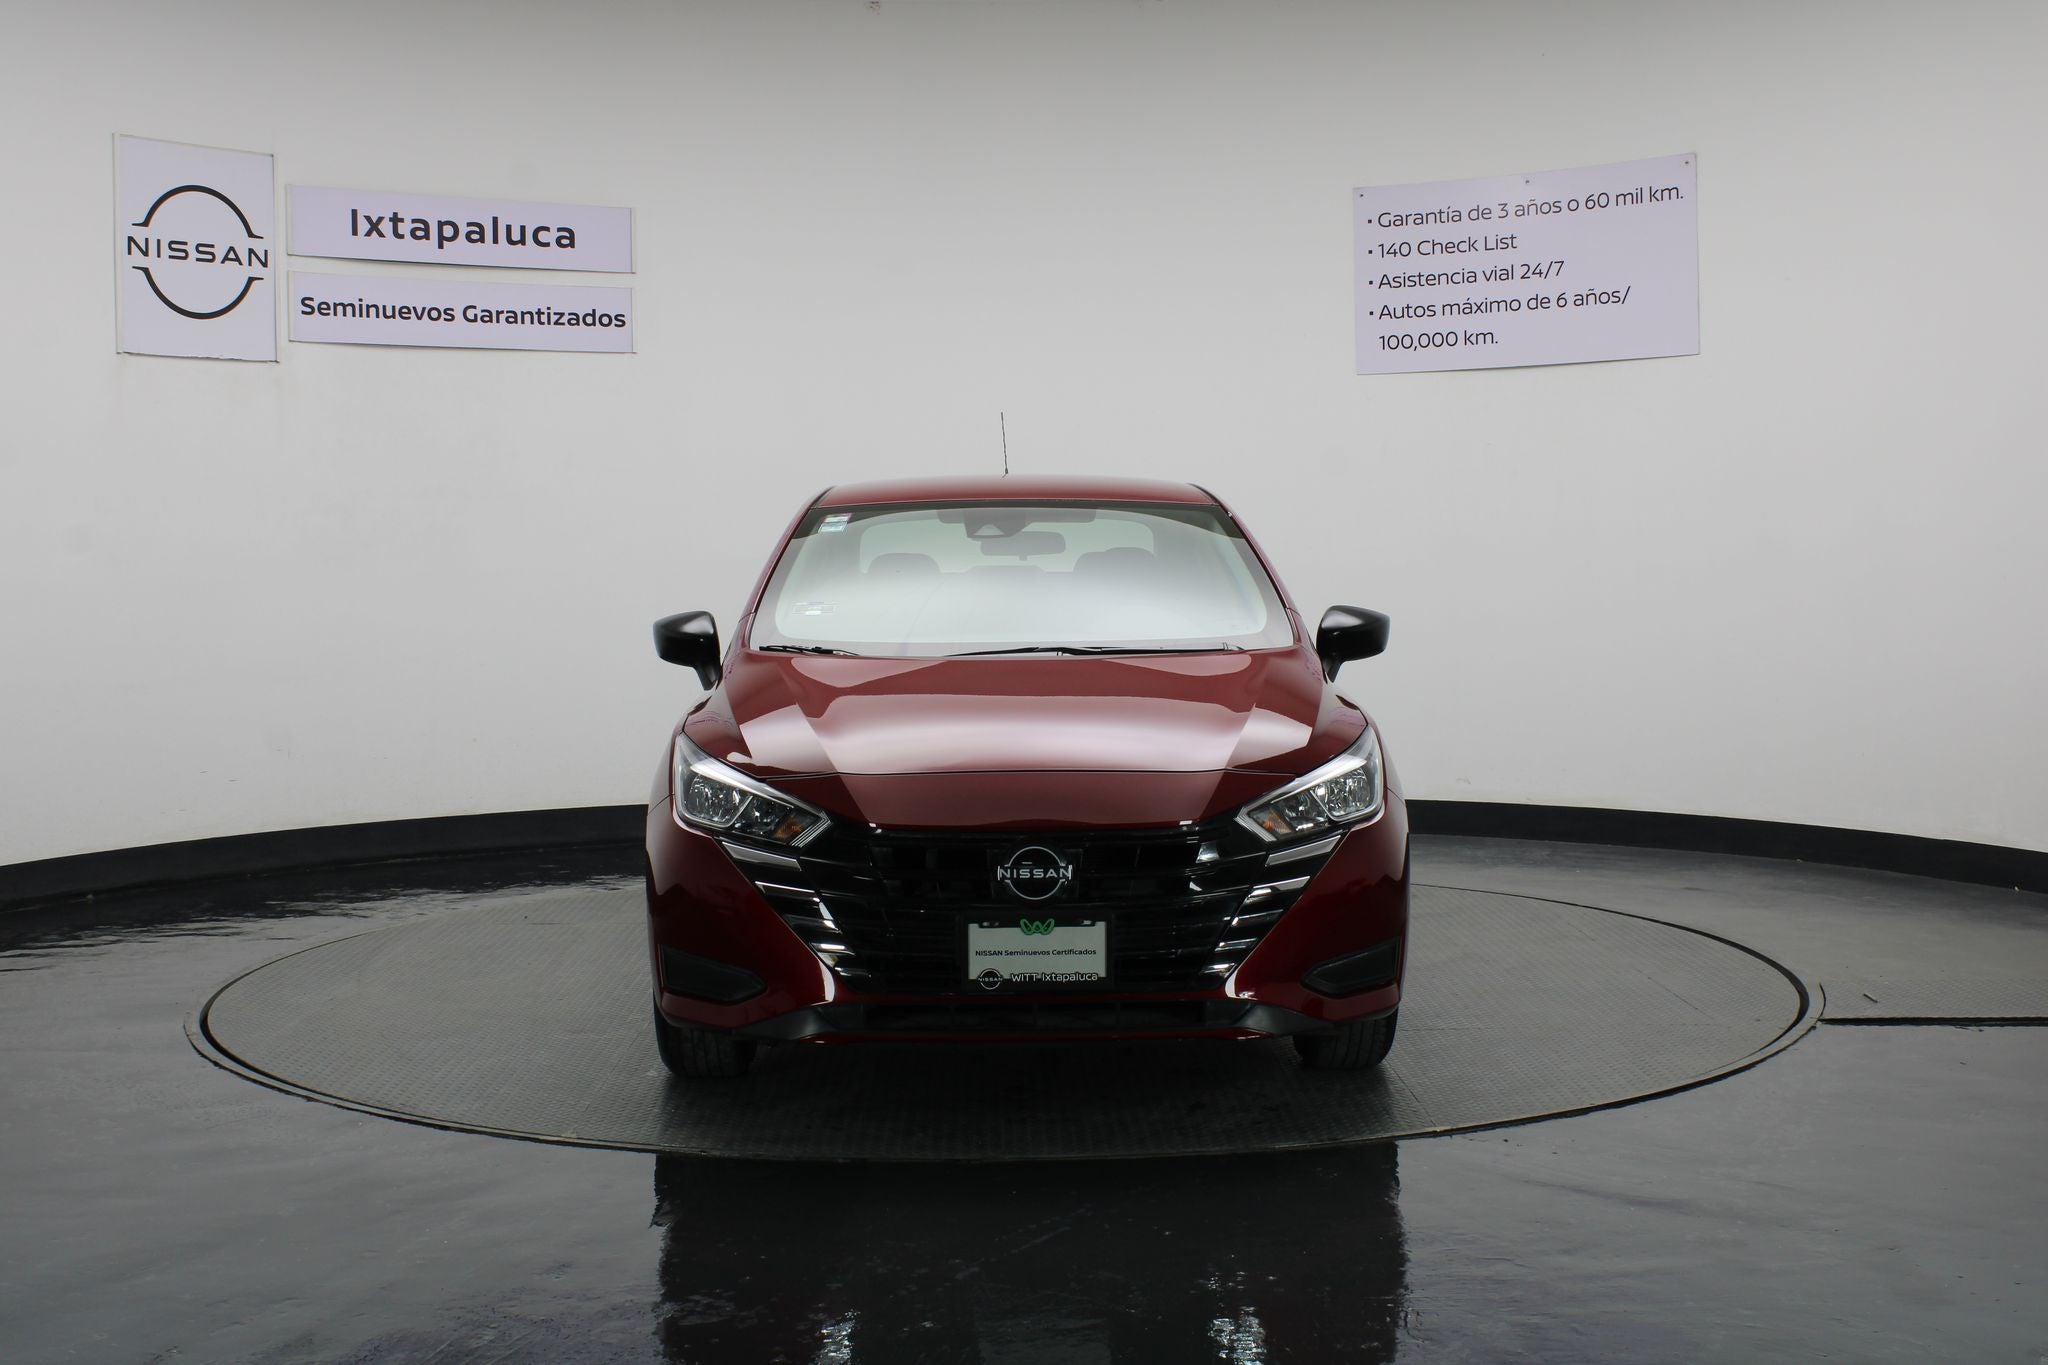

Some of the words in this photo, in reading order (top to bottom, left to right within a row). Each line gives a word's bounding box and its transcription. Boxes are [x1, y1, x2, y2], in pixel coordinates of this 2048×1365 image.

[1378, 206, 1462, 228] Garantía
[1467, 204, 1493, 222] de
[1497, 202, 1509, 219] 3
[1514, 199, 1562, 217] años
[1567, 198, 1580, 212] o
[1585, 191, 1611, 210] 60
[1615, 187, 1644, 207] mil
[1649, 185, 1684, 203] km.
[350, 208, 577, 249] Ixtapaluca
[127, 234, 269, 268] NISSAN
[1378, 241, 1412, 259] 140
[1417, 235, 1479, 257] Check
[1484, 233, 1518, 251] List
[1378, 268, 1478, 290] Asistencia
[1482, 264, 1514, 283] vial
[1520, 261, 1565, 281] 24/7
[300, 296, 456, 323] Seminuevos
[462, 304, 626, 329] Garantizados
[1378, 301, 1437, 321] Autos
[1441, 298, 1522, 316] máximo
[1526, 293, 1552, 311] de
[1556, 290, 1568, 308] 6
[1573, 285, 1631, 308] años/
[1378, 330, 1459, 352] 100,000
[1463, 329, 1499, 346] km.
[999, 868, 1071, 879] NISSAN
[1004, 948, 1050, 957] Seminuevos
[1051, 948, 1097, 956] Certificados
[1010, 973, 1038, 982] WITT
[1041, 971, 1098, 983] Ixtapaluca
